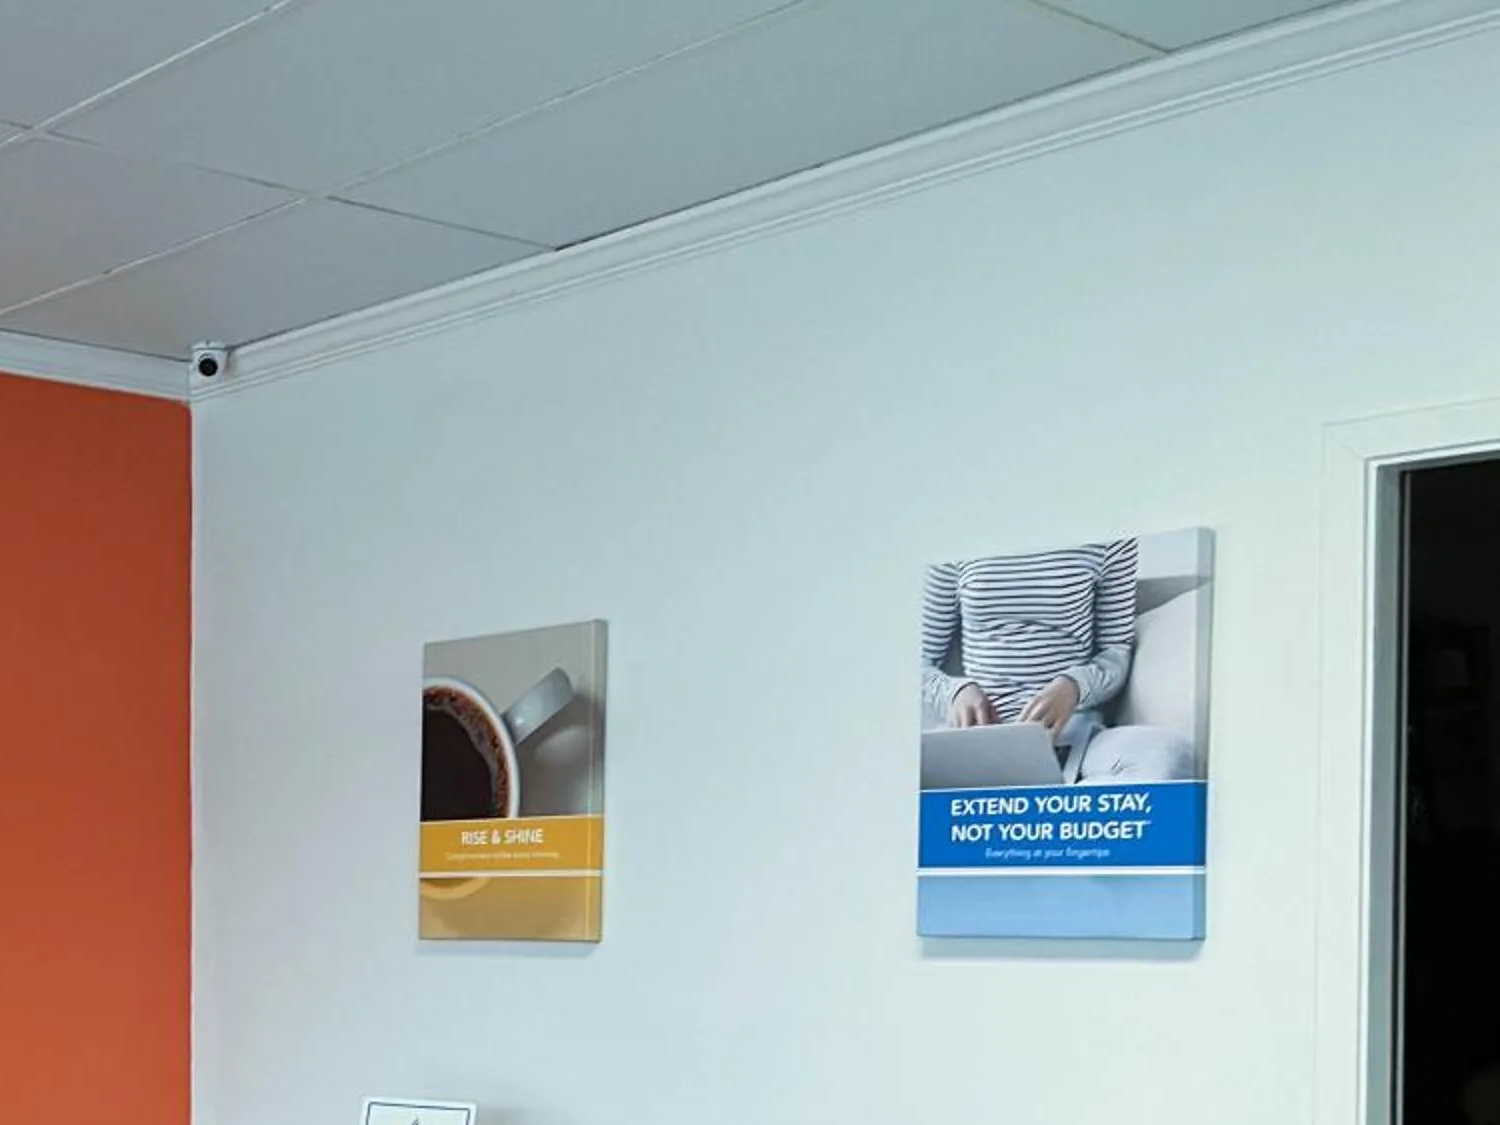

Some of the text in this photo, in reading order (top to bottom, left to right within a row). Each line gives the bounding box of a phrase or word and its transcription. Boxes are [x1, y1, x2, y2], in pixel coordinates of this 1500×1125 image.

[951, 792, 1152, 816] EXTEND YOUR STAY,
[461, 828, 544, 845] RISE & SHINE
[951, 820, 1146, 842] NOT YOUR BUDGET
